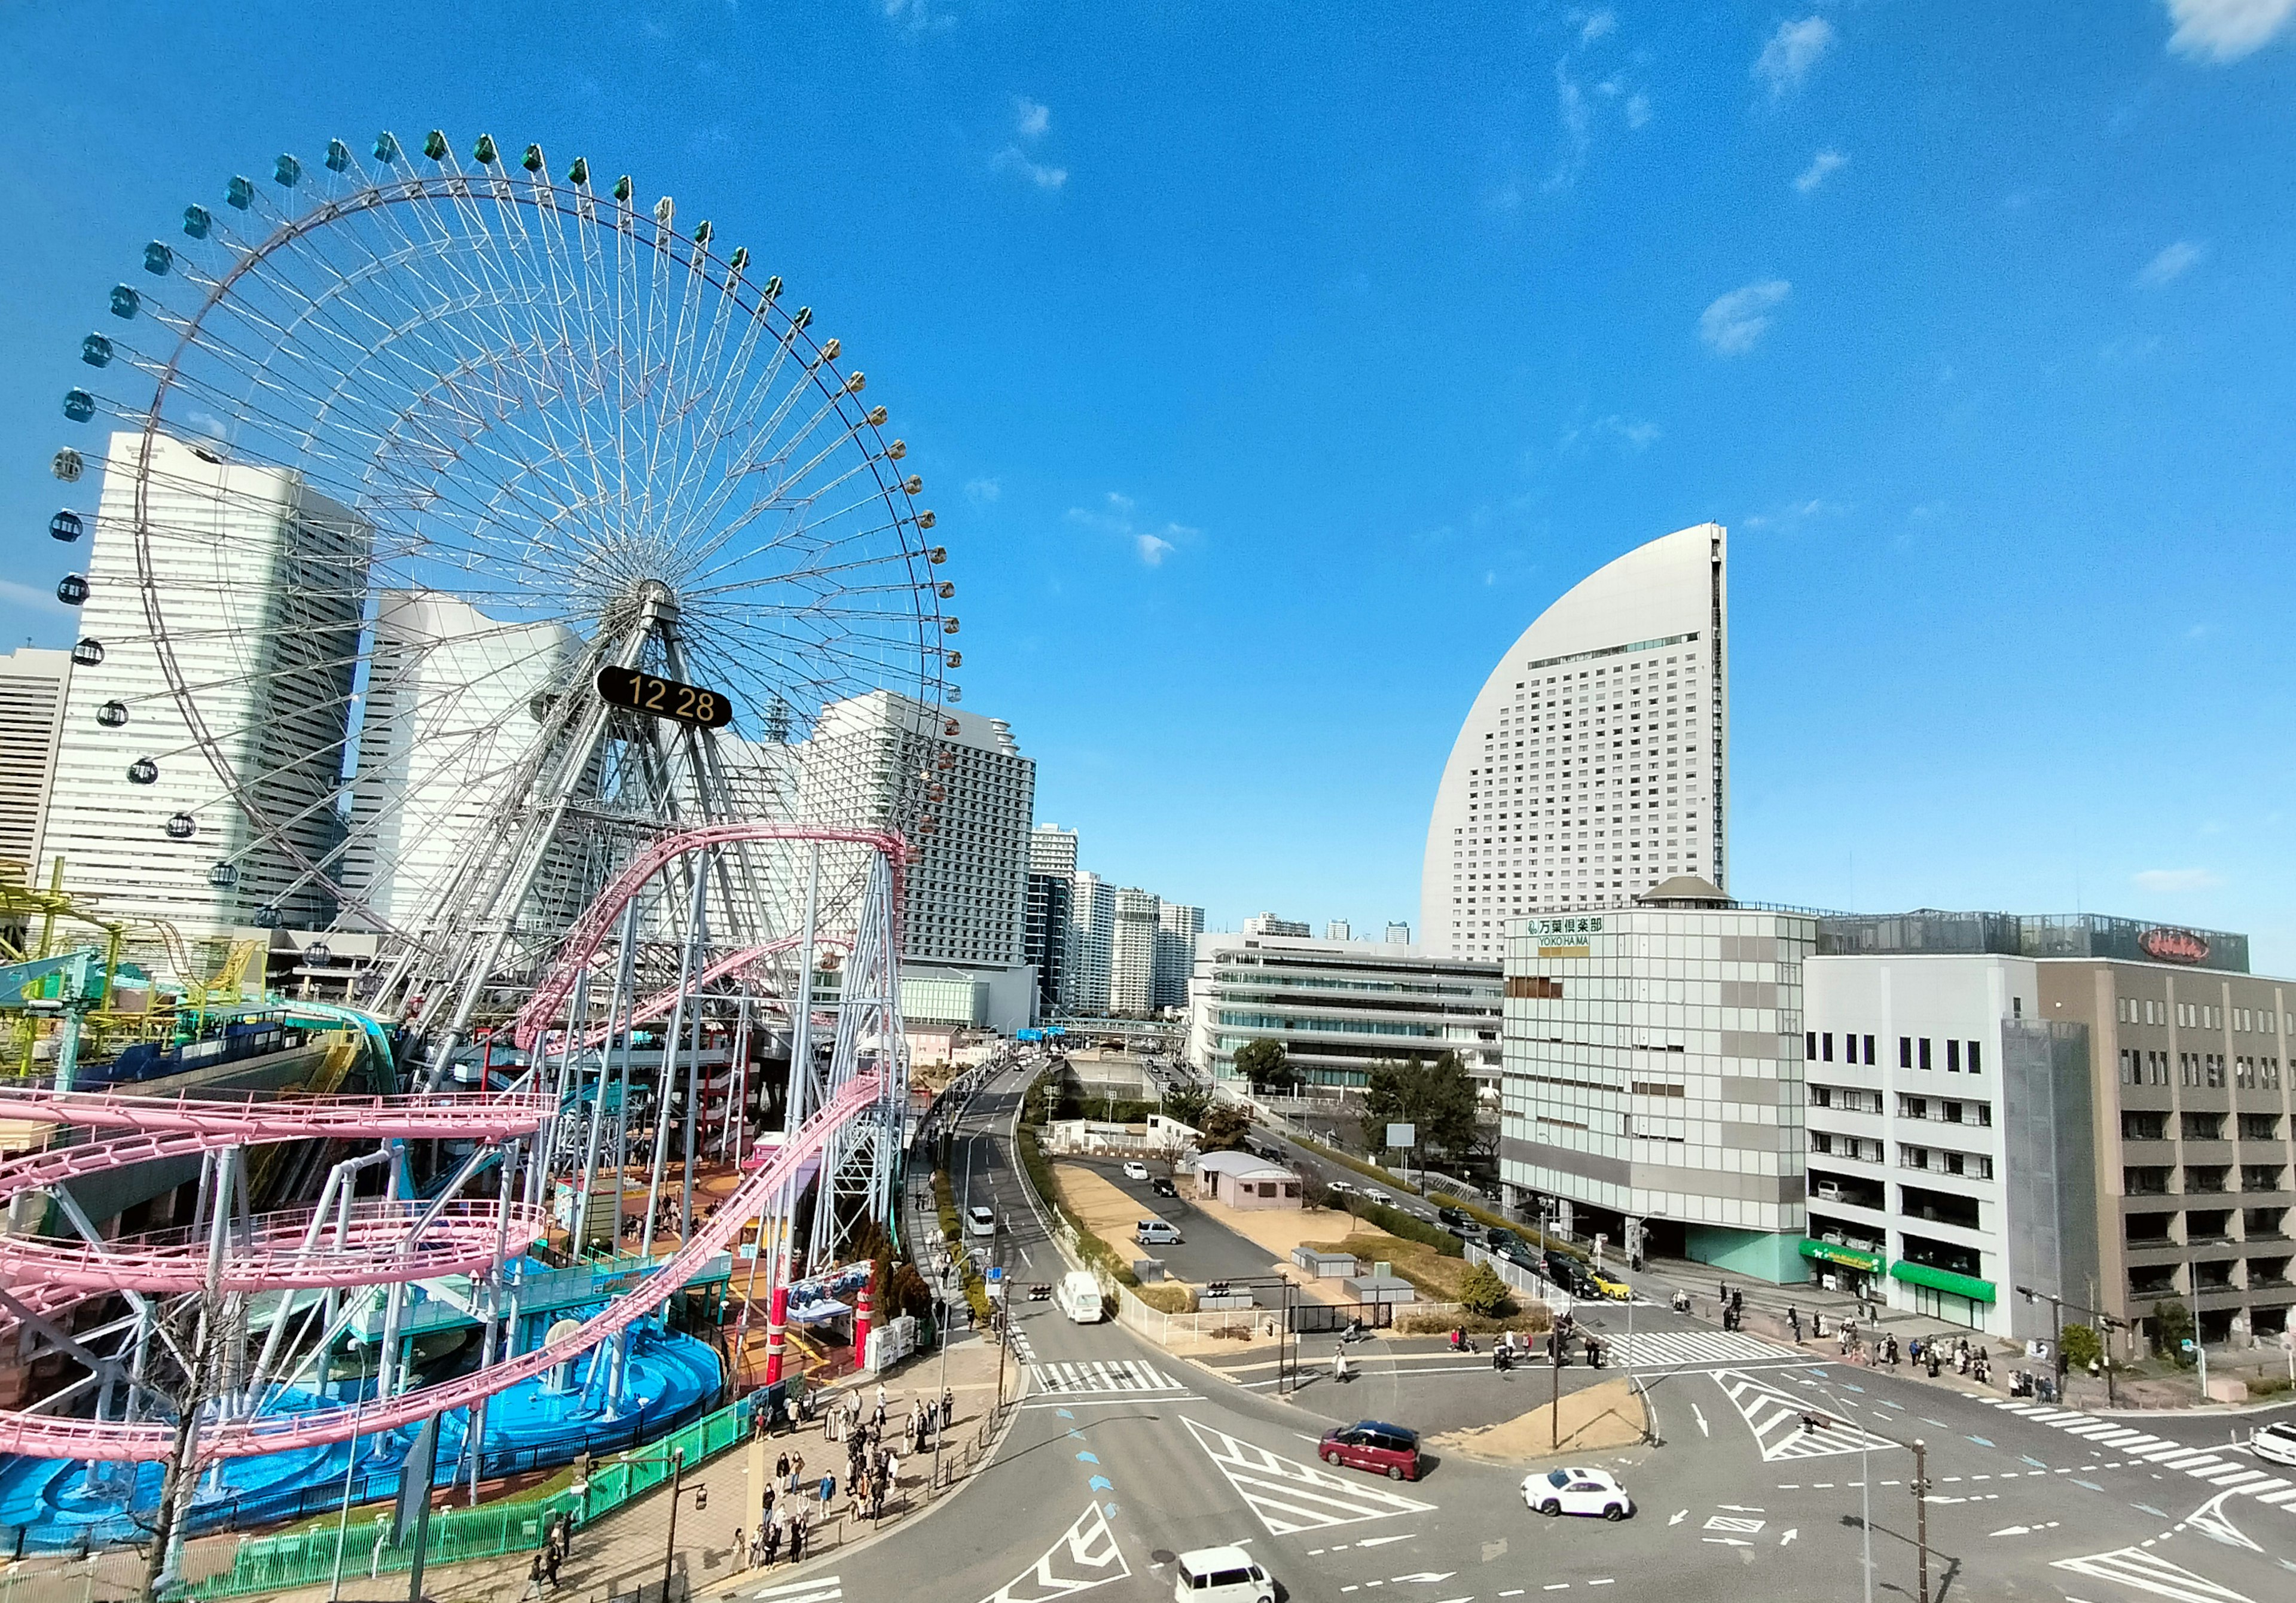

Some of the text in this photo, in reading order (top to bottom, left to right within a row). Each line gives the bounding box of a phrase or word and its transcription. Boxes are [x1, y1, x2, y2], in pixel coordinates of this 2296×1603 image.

[629, 675, 714, 721] 12 28
[1539, 936, 1589, 946] YOKOHAMA
